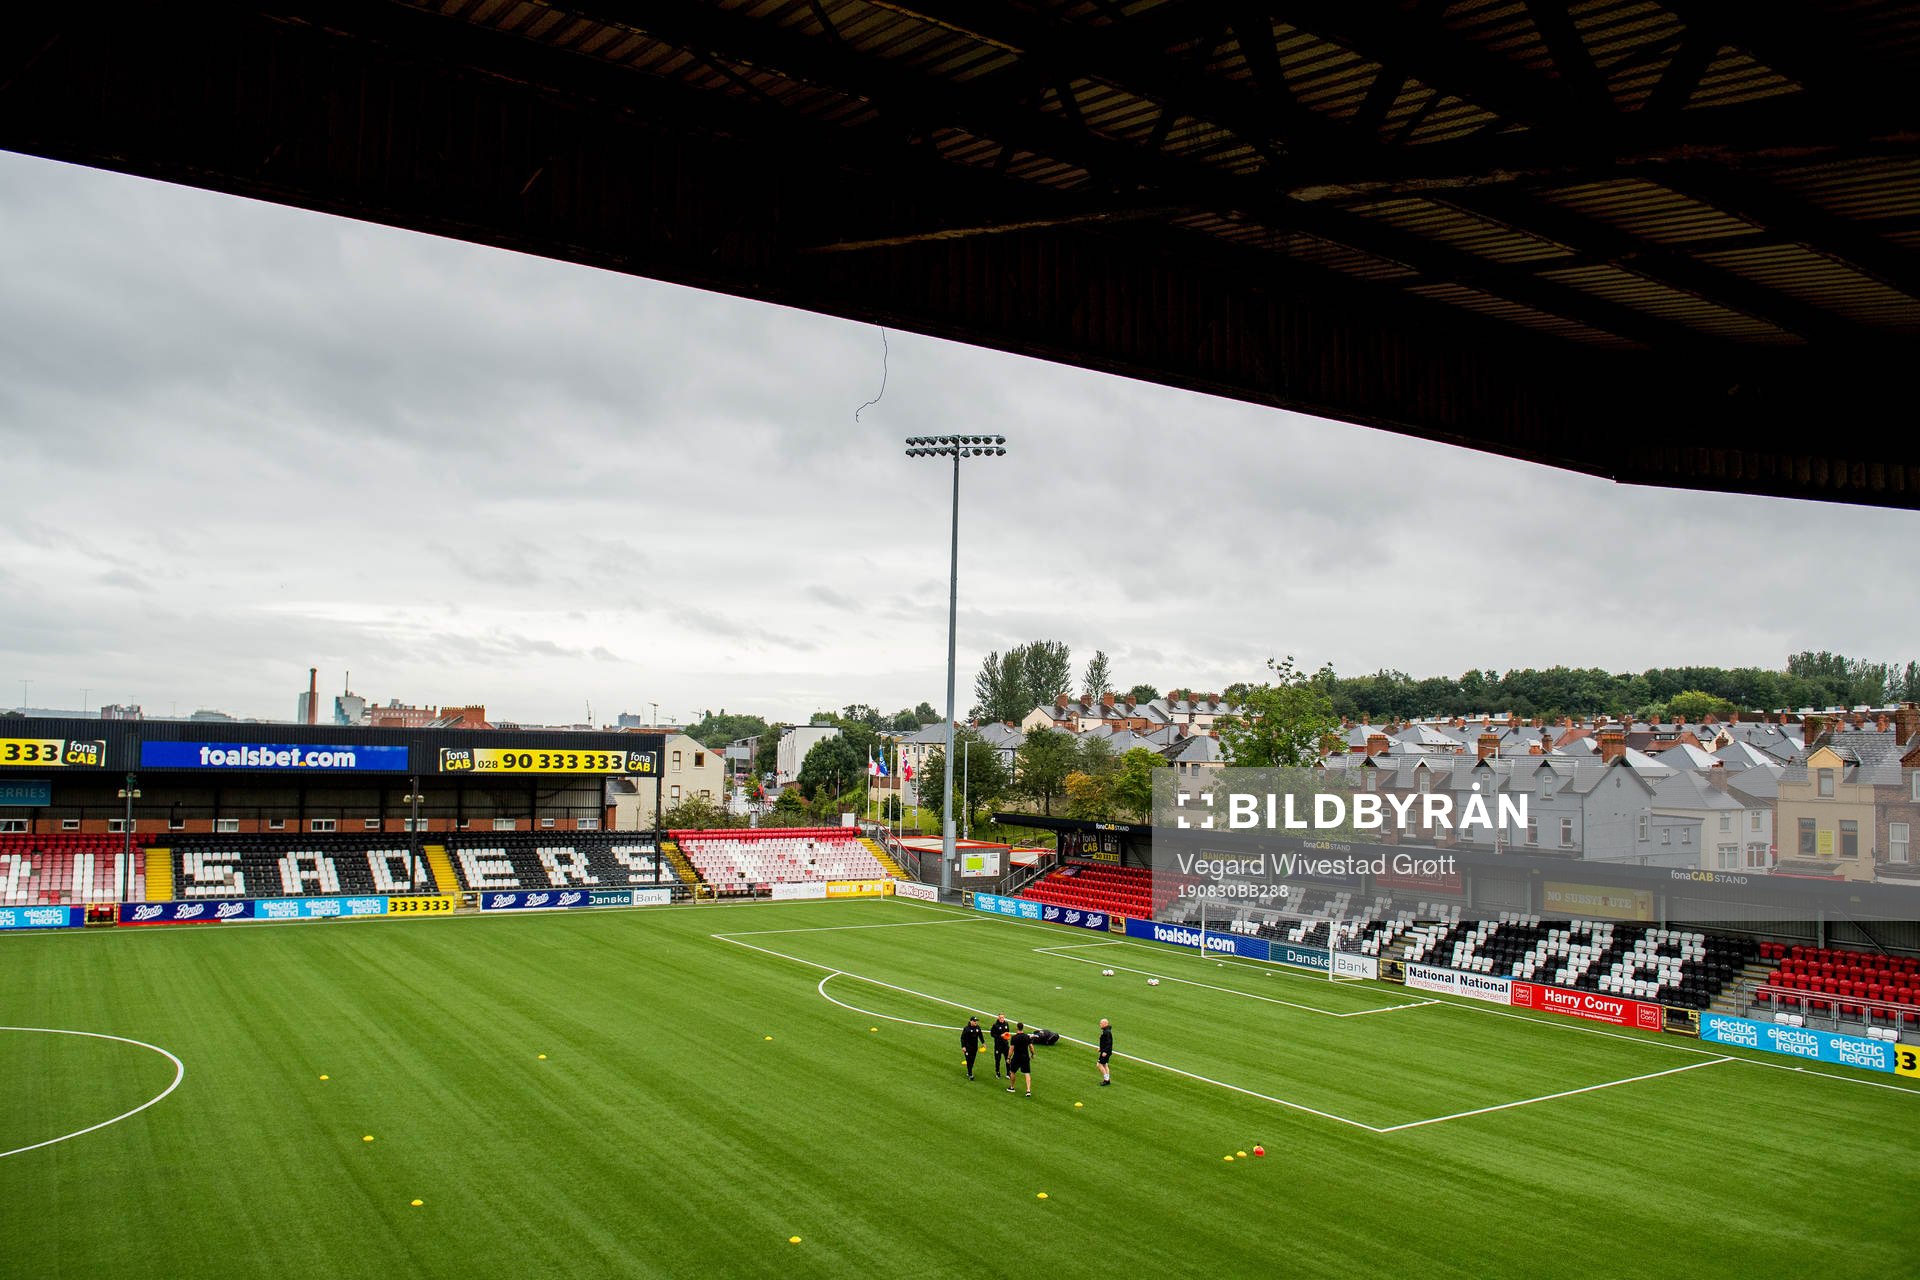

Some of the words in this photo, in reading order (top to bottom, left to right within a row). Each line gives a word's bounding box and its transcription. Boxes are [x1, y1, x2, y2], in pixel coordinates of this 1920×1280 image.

[5, 744, 58, 761] 333
[70, 741, 97, 754] fona
[446, 750, 469, 760] fona
[66, 752, 97, 765] CAB
[200, 746, 356, 767] toalsbet.com
[478, 760, 498, 769] 028
[502, 753, 533, 769] 90
[538, 754, 578, 769] 333
[584, 754, 623, 770] 333
[630, 751, 650, 763] fona
[446, 760, 471, 770] CAB
[628, 761, 650, 772] CAB
[1082, 842, 1098, 853] CAB
[1715, 875, 1748, 885] STAND
[524, 892, 549, 907] Boots
[557, 892, 582, 906] Boots
[588, 894, 630, 904] Danske
[636, 893, 663, 903] Bank
[907, 885, 935, 899] Kappa
[389, 901, 418, 912] 333
[422, 900, 450, 911] 333
[491, 893, 516, 908] Boots
[1547, 891, 1561, 901] NO
[1565, 893, 1631, 909] SUBSTITUTE
[131, 904, 163, 920] Boots
[173, 903, 205, 919] Boots
[214, 902, 245, 918] Boots
[1043, 906, 1060, 920] Boots
[1064, 909, 1081, 924] Boots
[1085, 913, 1103, 928] Boots
[1154, 925, 1236, 953] toalsbet.com
[1287, 950, 1330, 968] Danske
[1338, 958, 1368, 974] Bank
[1409, 966, 1454, 984] National
[1409, 977, 1455, 993] Windscreens
[1460, 975, 1508, 993] National
[1515, 986, 1529, 996] Harry
[1460, 986, 1508, 1003] Windscreens
[1515, 992, 1529, 1001] Corry
[1544, 988, 1581, 1009] Harry
[1584, 996, 1624, 1016] Corry
[1640, 1008, 1656, 1018] Harry
[1640, 1013, 1657, 1023] Corry
[1710, 1018, 1757, 1035] electric
[1717, 1028, 1758, 1047] Ireland
[1767, 1028, 1818, 1045] electric
[1776, 1037, 1819, 1057] Ireland
[1830, 1038, 1884, 1056] electric
[1839, 1047, 1885, 1069] Ireland
